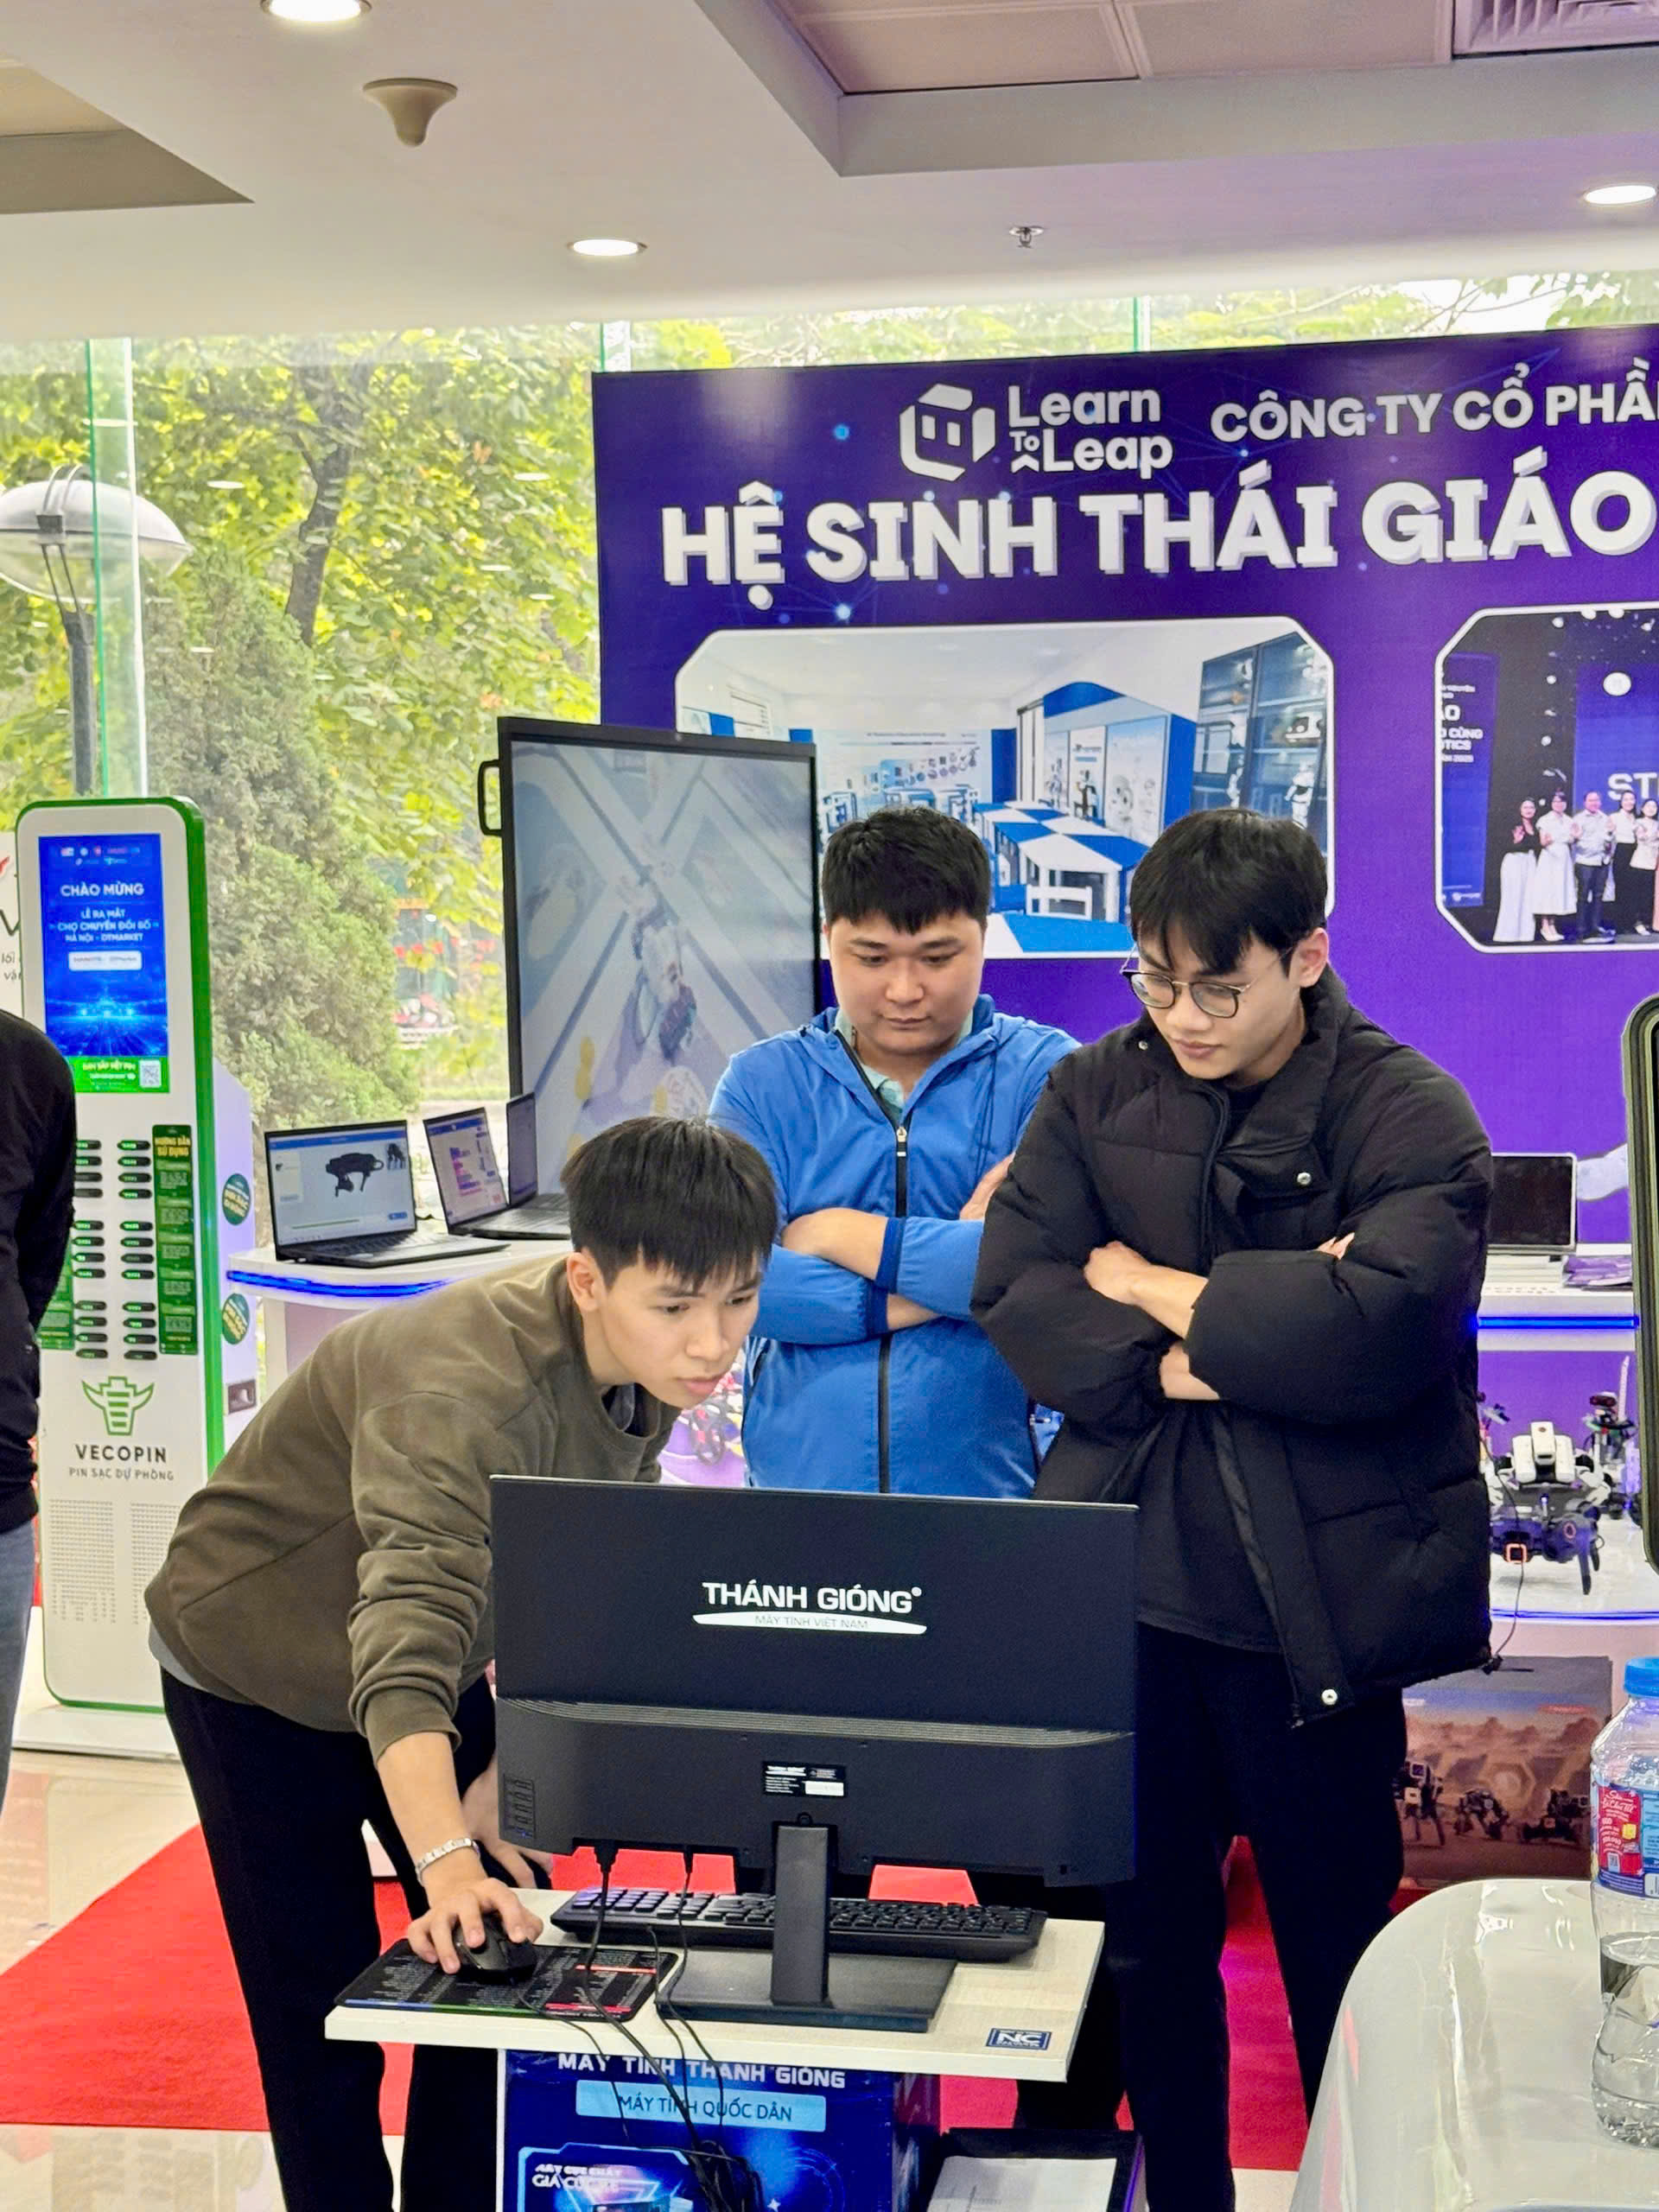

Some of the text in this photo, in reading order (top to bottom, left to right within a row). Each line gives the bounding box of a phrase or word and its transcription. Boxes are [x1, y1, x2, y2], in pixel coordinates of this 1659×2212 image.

[1007, 385, 1161, 428] Learn
[1210, 357, 1659, 443] CÔNG TY CỔ PHẦ
[1009, 428, 1173, 480] To Leap
[662, 446, 1657, 610] HỆ SINH THÁI GIÁO
[1608, 772, 1659, 801] ST
[60, 880, 145, 896] CHÀO MỪNG
[75, 1444, 167, 1463] VECOPIN
[69, 1467, 87, 1478] PIN
[702, 1579, 912, 1613] THÁNH GIÓNG
[841, 1619, 868, 1629] NAM
[619, 2092, 654, 2112] MÁY
[702, 2097, 753, 2118] QUỐC
[757, 2101, 792, 2121] DÂN
